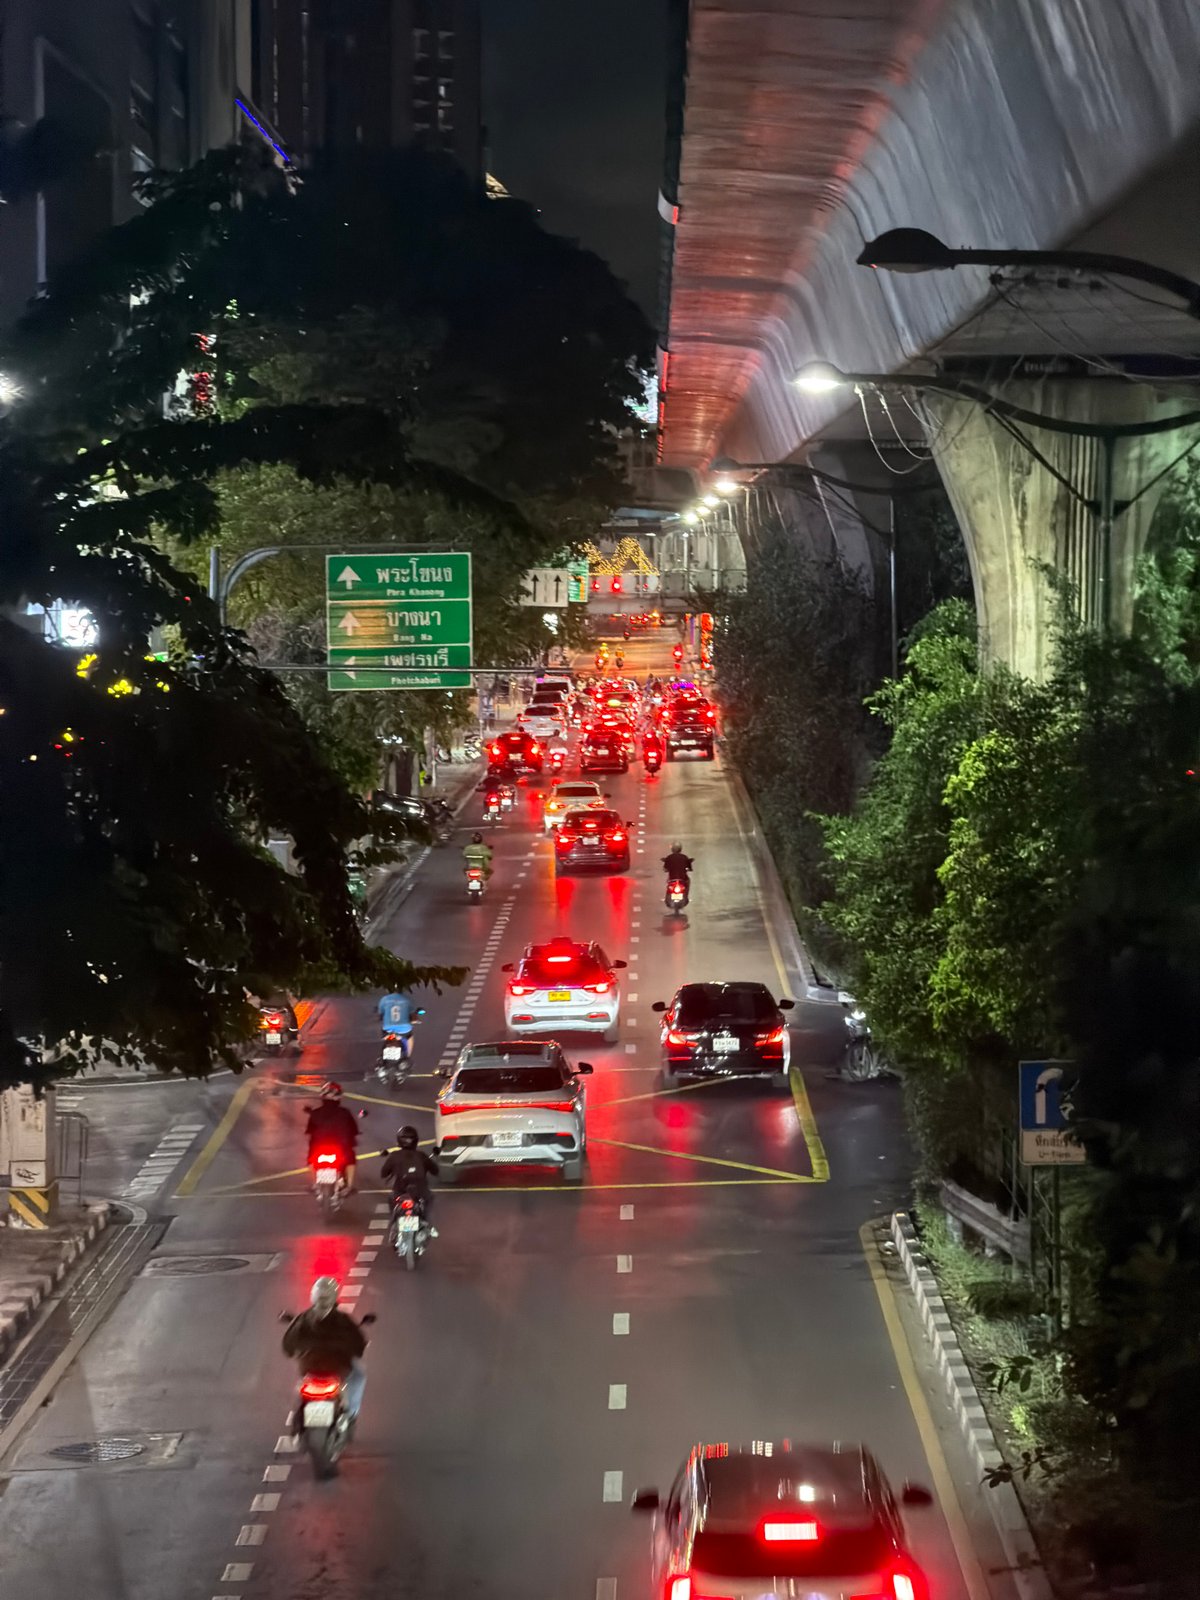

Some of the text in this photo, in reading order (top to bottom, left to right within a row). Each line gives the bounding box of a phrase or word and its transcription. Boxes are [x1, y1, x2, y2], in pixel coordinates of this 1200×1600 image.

[376, 557, 453, 583] พระโขนง
[386, 588, 445, 598] Phra Khanong
[386, 610, 442, 626] บางนา
[390, 1005, 401, 1022] 6
